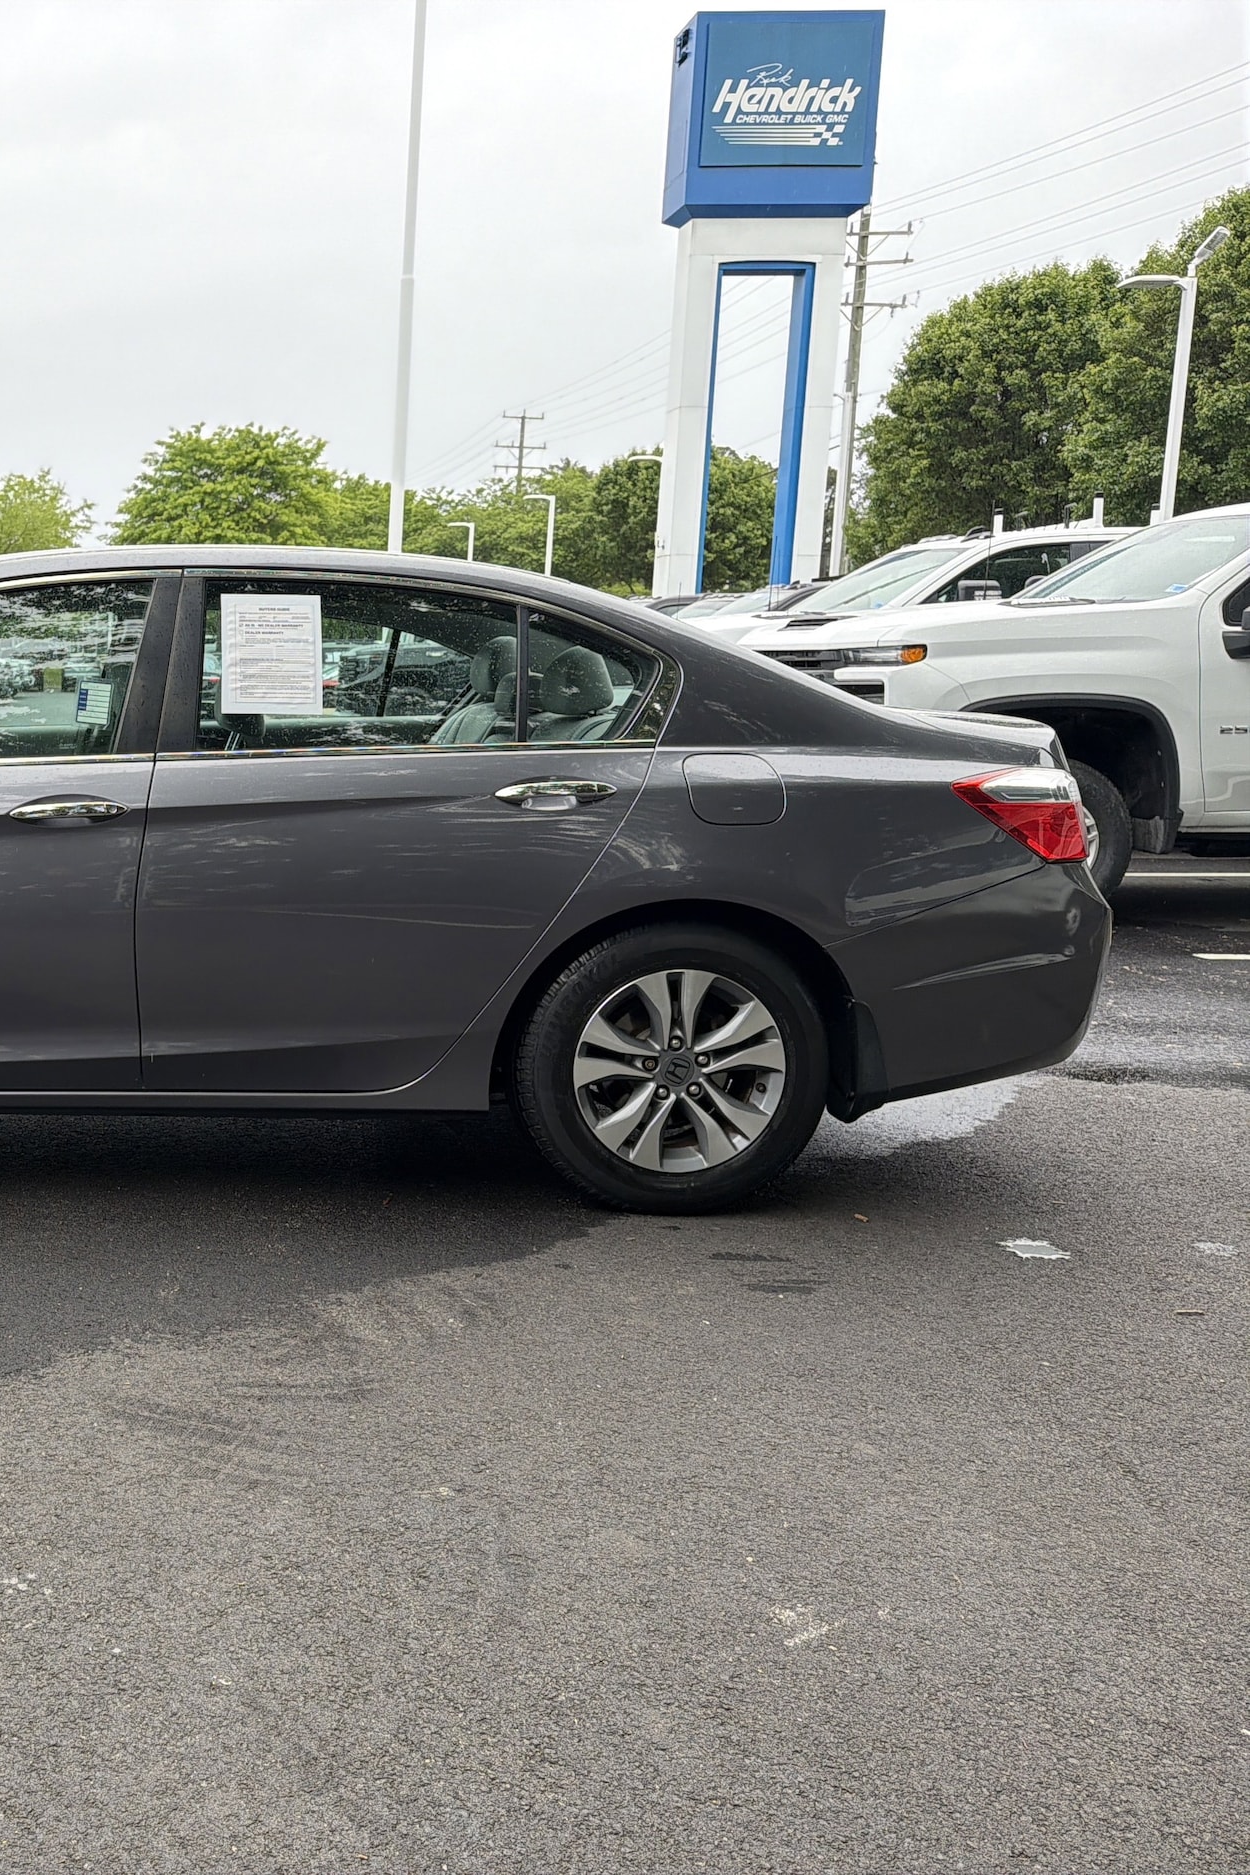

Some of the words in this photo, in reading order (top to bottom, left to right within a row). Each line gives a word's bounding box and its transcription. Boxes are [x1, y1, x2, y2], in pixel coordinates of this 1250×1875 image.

[712, 78, 862, 123] Hendrick
[735, 114, 792, 123] CHEVROLET
[793, 114, 824, 123] BUICK
[825, 114, 849, 123] GMC
[1220, 725, 1250, 735] 25
